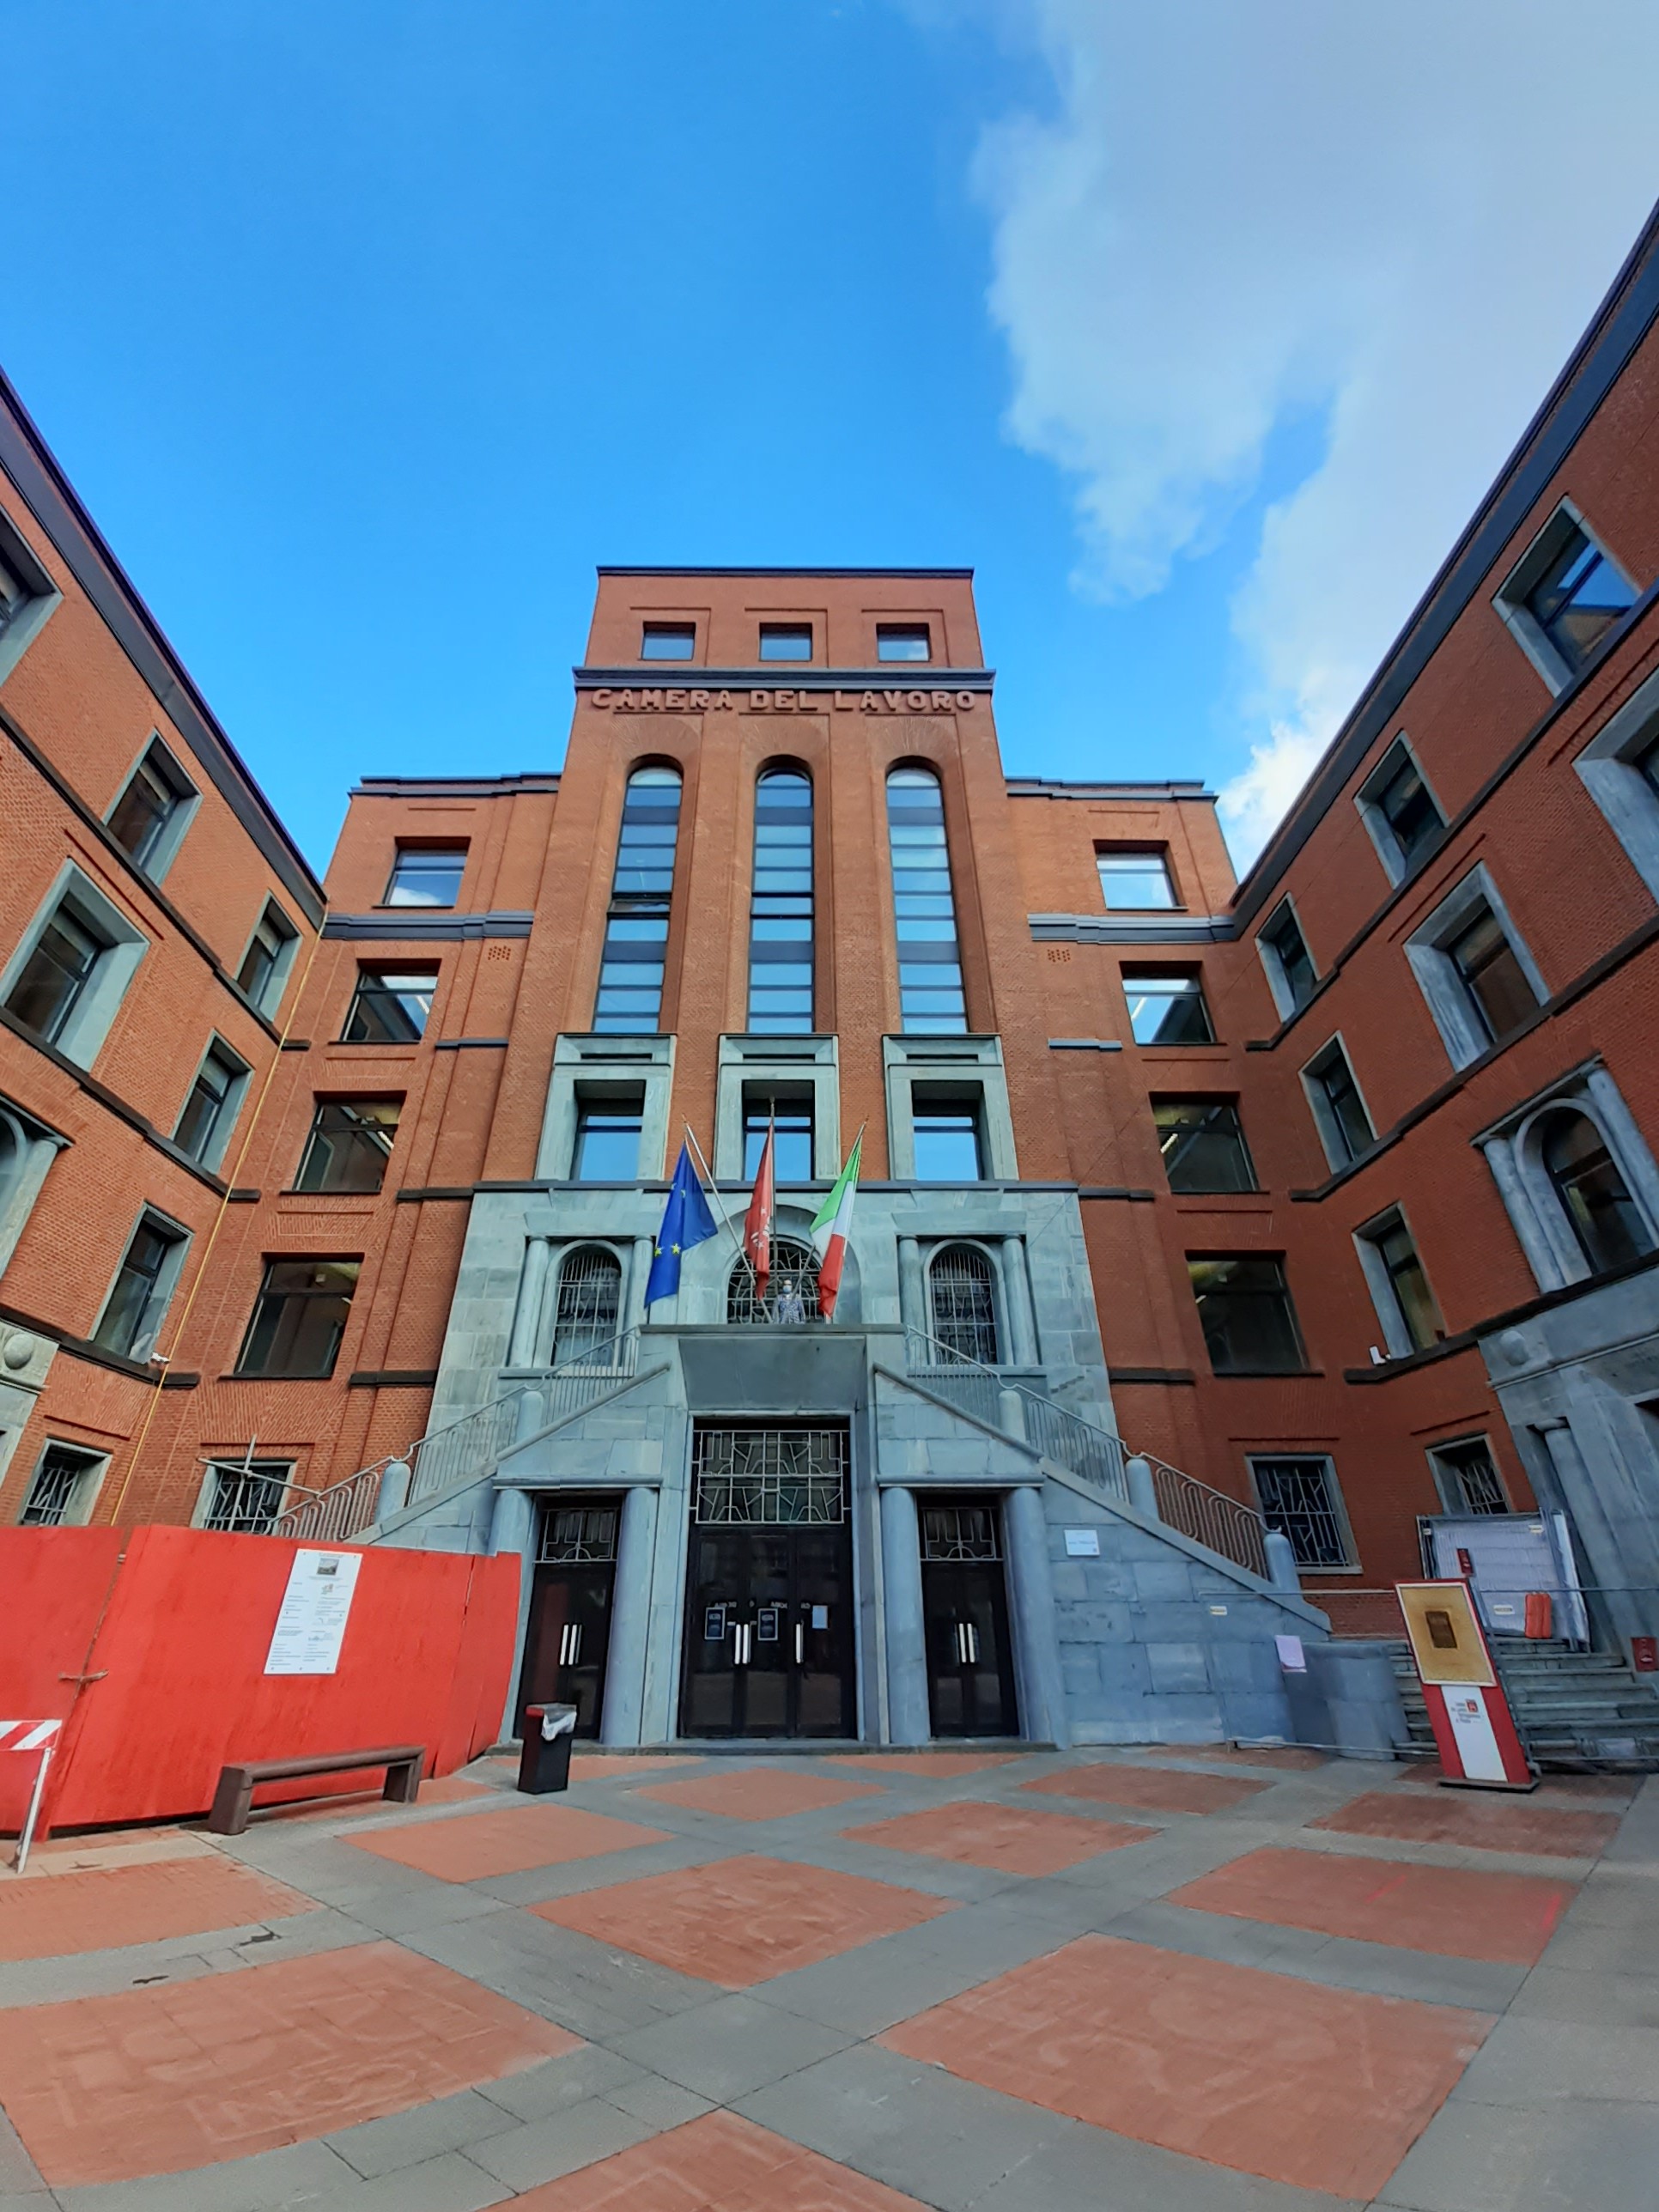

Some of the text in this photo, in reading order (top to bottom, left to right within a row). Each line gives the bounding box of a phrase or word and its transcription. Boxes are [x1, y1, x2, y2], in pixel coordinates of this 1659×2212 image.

[592, 689, 976, 711] CAMERA DEL LAVORO
